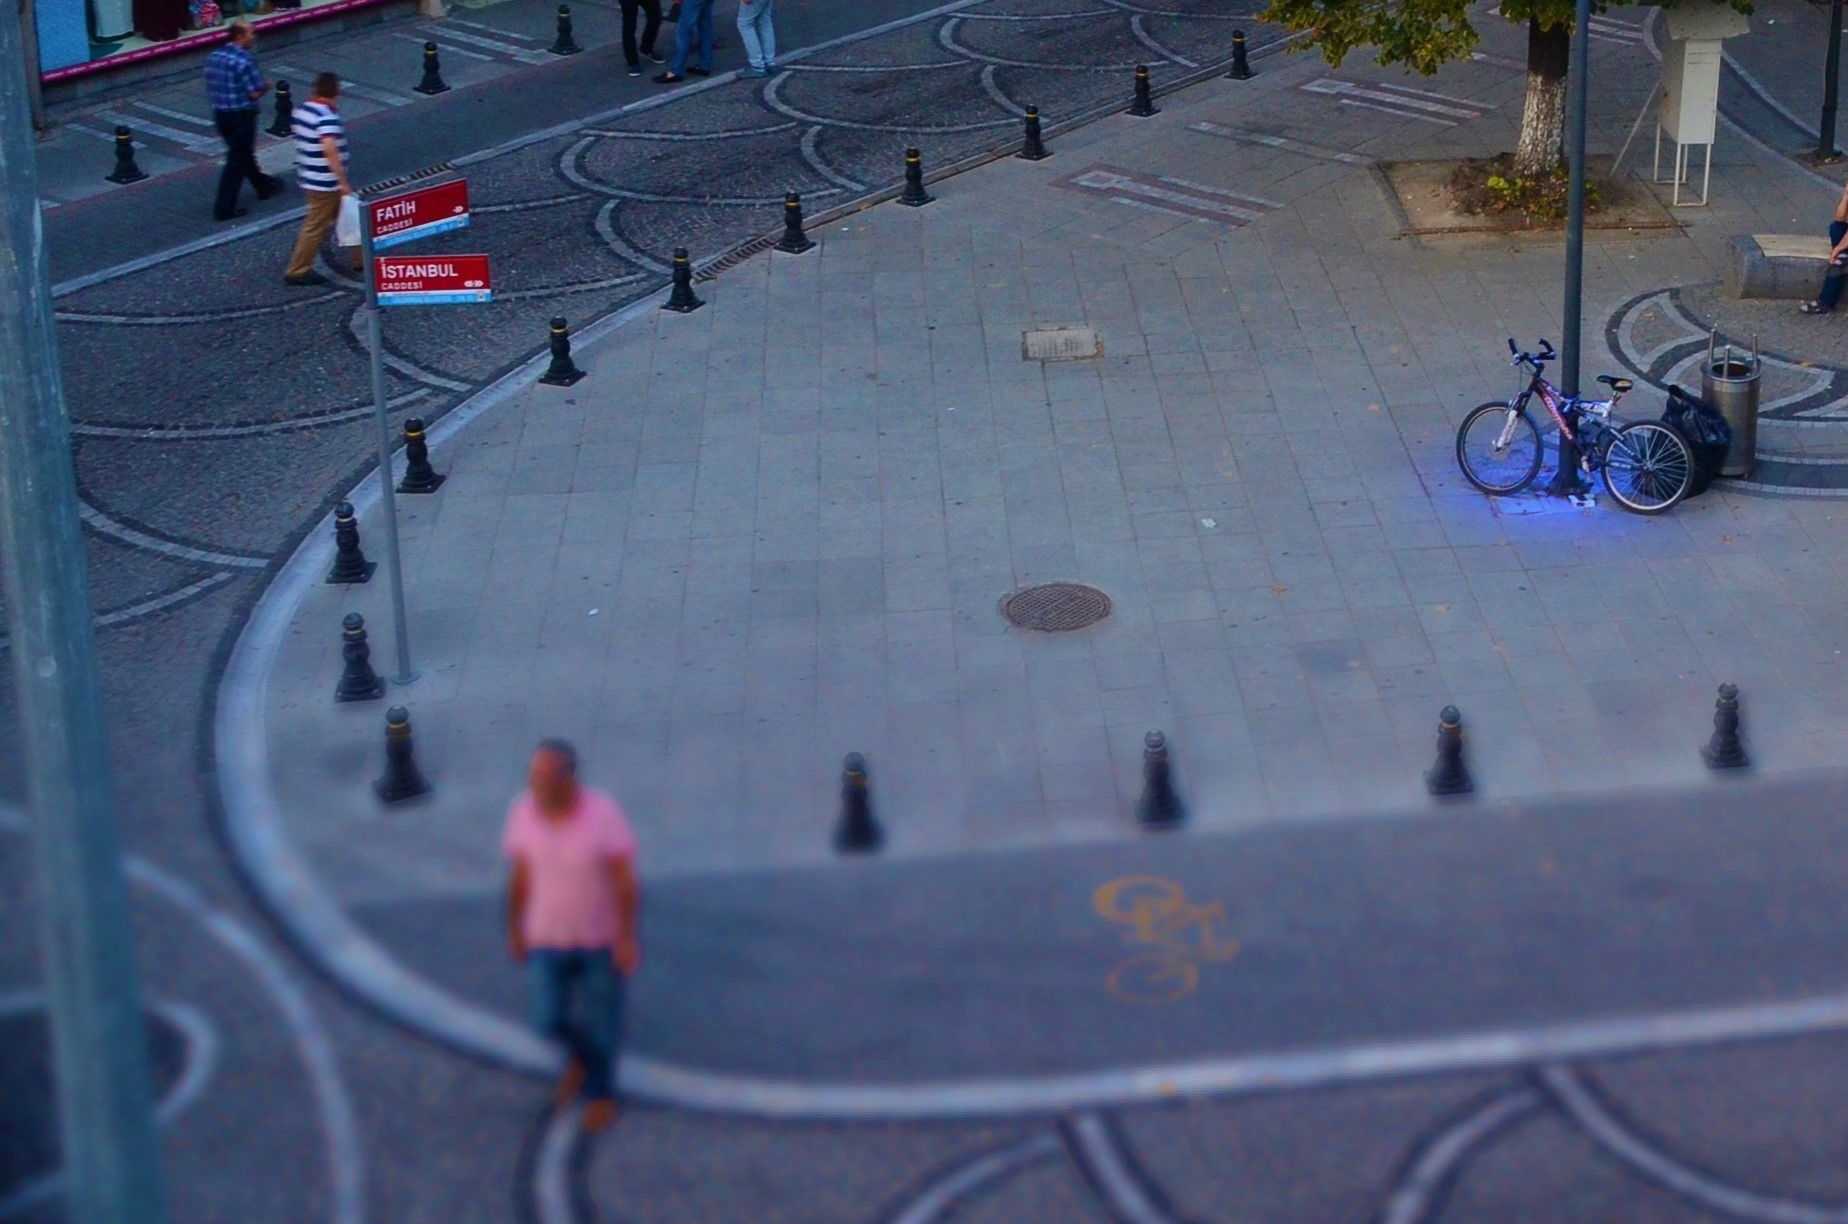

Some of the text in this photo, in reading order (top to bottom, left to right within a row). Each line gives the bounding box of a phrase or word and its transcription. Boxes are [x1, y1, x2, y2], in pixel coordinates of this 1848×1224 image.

[376, 200, 416, 223] FATİH
[376, 218, 413, 234] CADDESİ
[381, 263, 459, 279] İSTANBUL
[381, 280, 423, 290] CADDESİ
